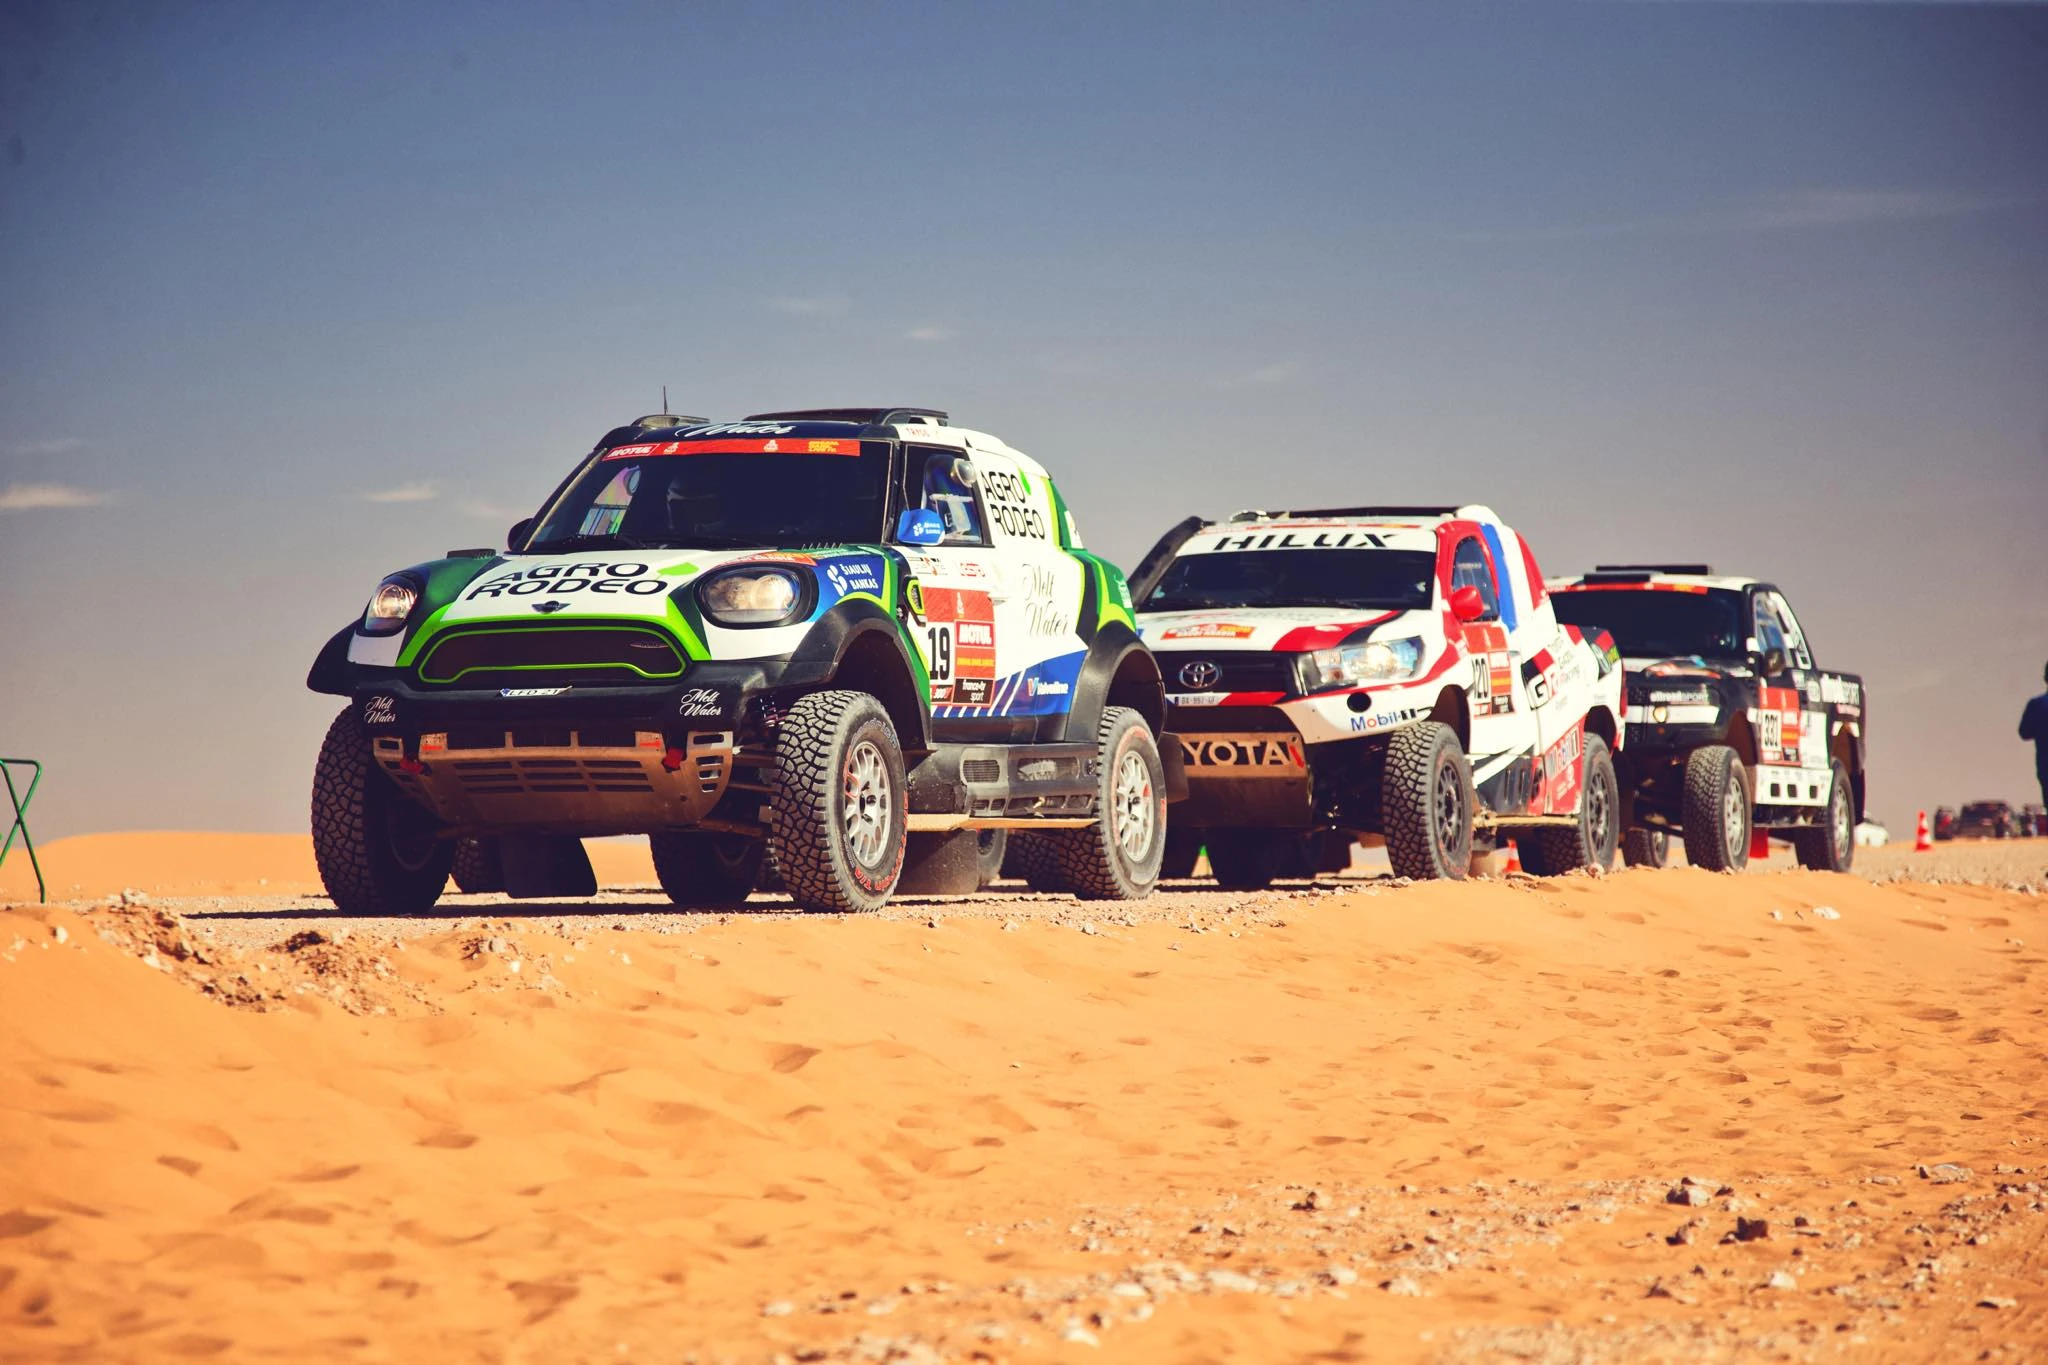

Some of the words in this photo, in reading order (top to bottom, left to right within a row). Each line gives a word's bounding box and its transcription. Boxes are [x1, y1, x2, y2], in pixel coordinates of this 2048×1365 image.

[608, 446, 652, 458] MOTUL
[980, 471, 1026, 504] AGRO
[989, 504, 1046, 540] RODEO
[1212, 533, 1399, 551] HILUX
[485, 562, 650, 584] AGRO
[465, 578, 668, 601] RODEO
[849, 578, 879, 591] BANKAS
[958, 624, 992, 645] MOTUL
[928, 626, 950, 681] 19
[365, 696, 394, 711] Melt
[681, 688, 720, 704] Melt
[363, 709, 396, 724] Water
[679, 702, 722, 717] Water
[1350, 711, 1397, 732] Mobil
